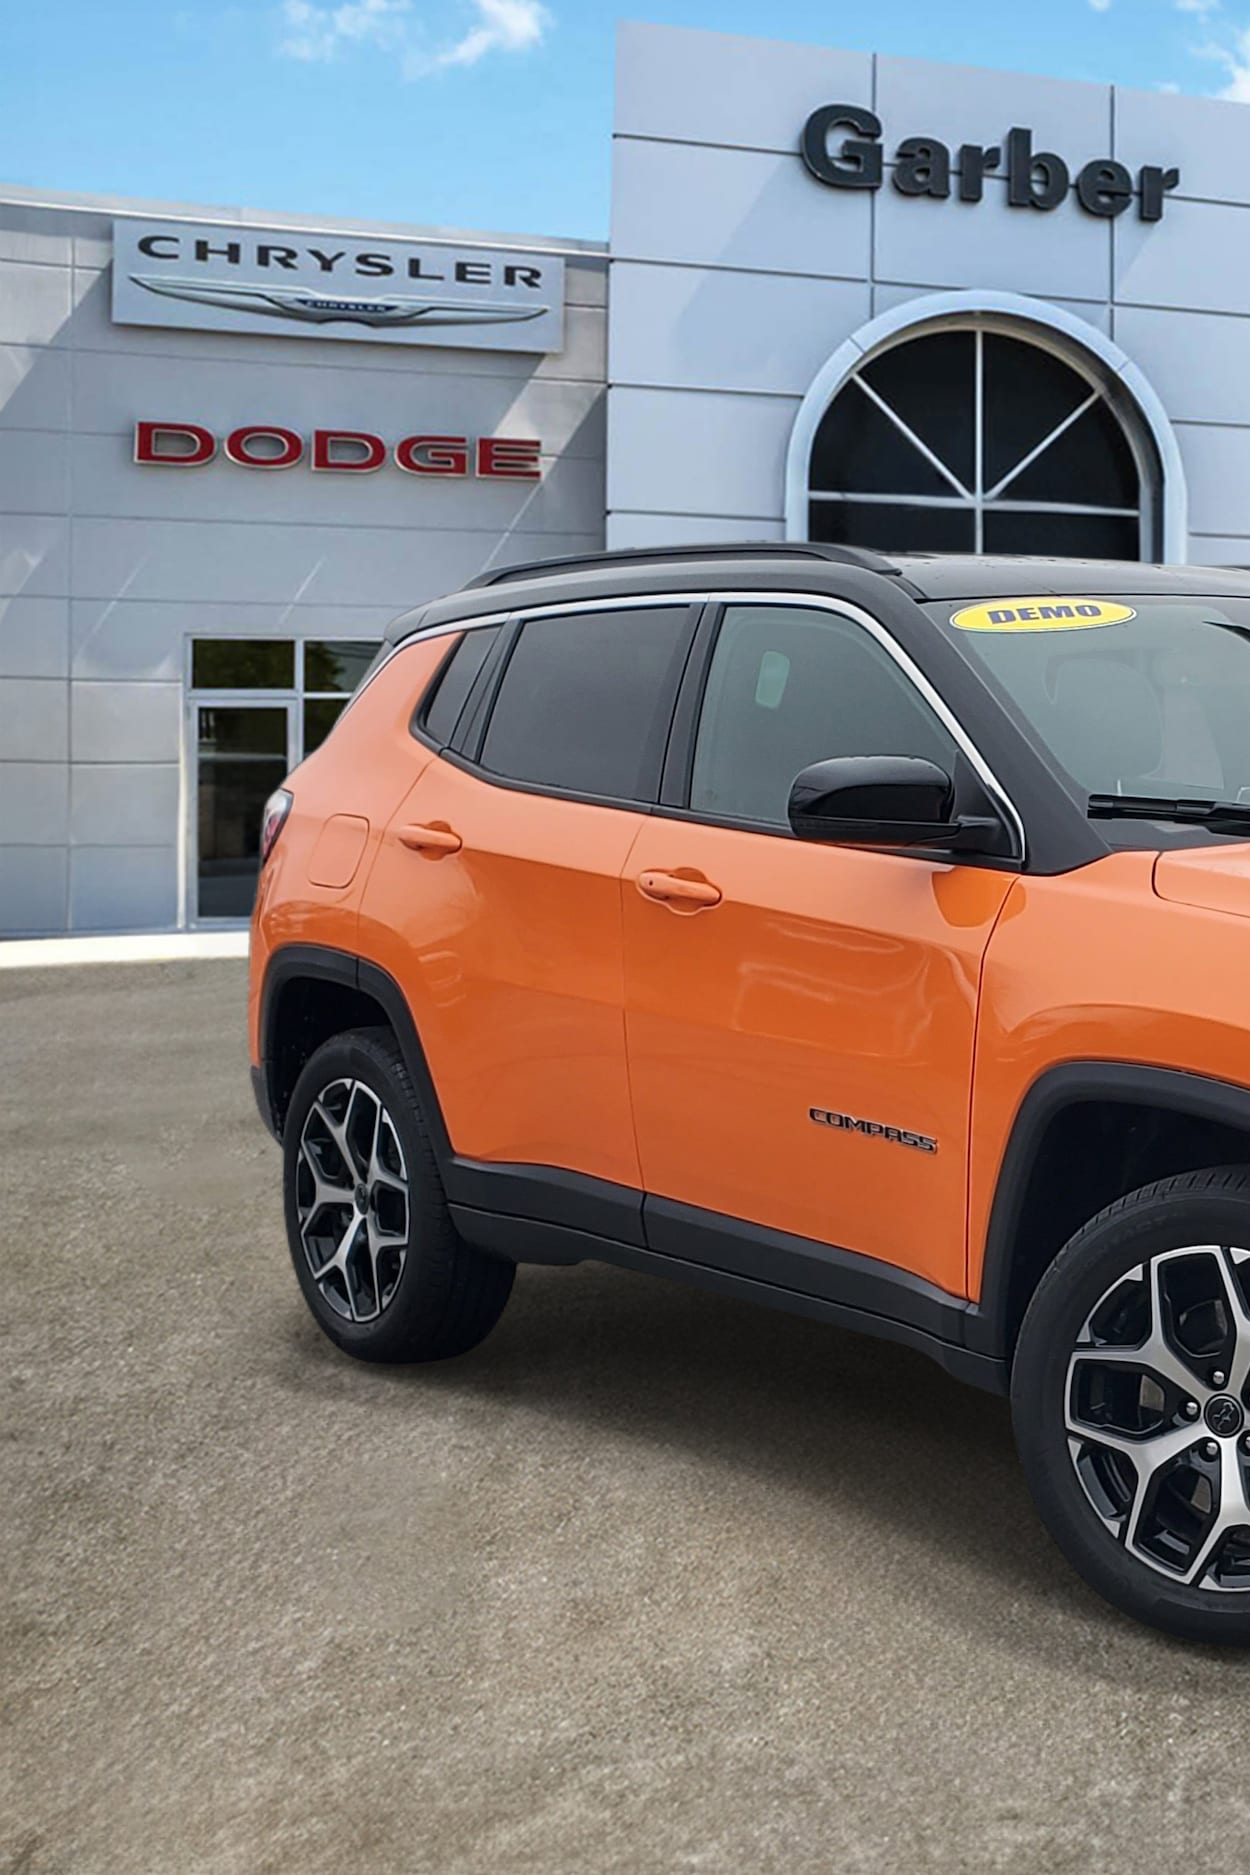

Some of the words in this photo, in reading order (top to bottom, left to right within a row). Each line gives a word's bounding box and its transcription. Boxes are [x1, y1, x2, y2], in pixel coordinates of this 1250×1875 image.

[802, 103, 1180, 222] Garber
[137, 234, 543, 289] CHRYSLER
[133, 420, 542, 480] DODGE
[987, 604, 1103, 625] DEMO
[808, 1107, 938, 1154] COMPASS
